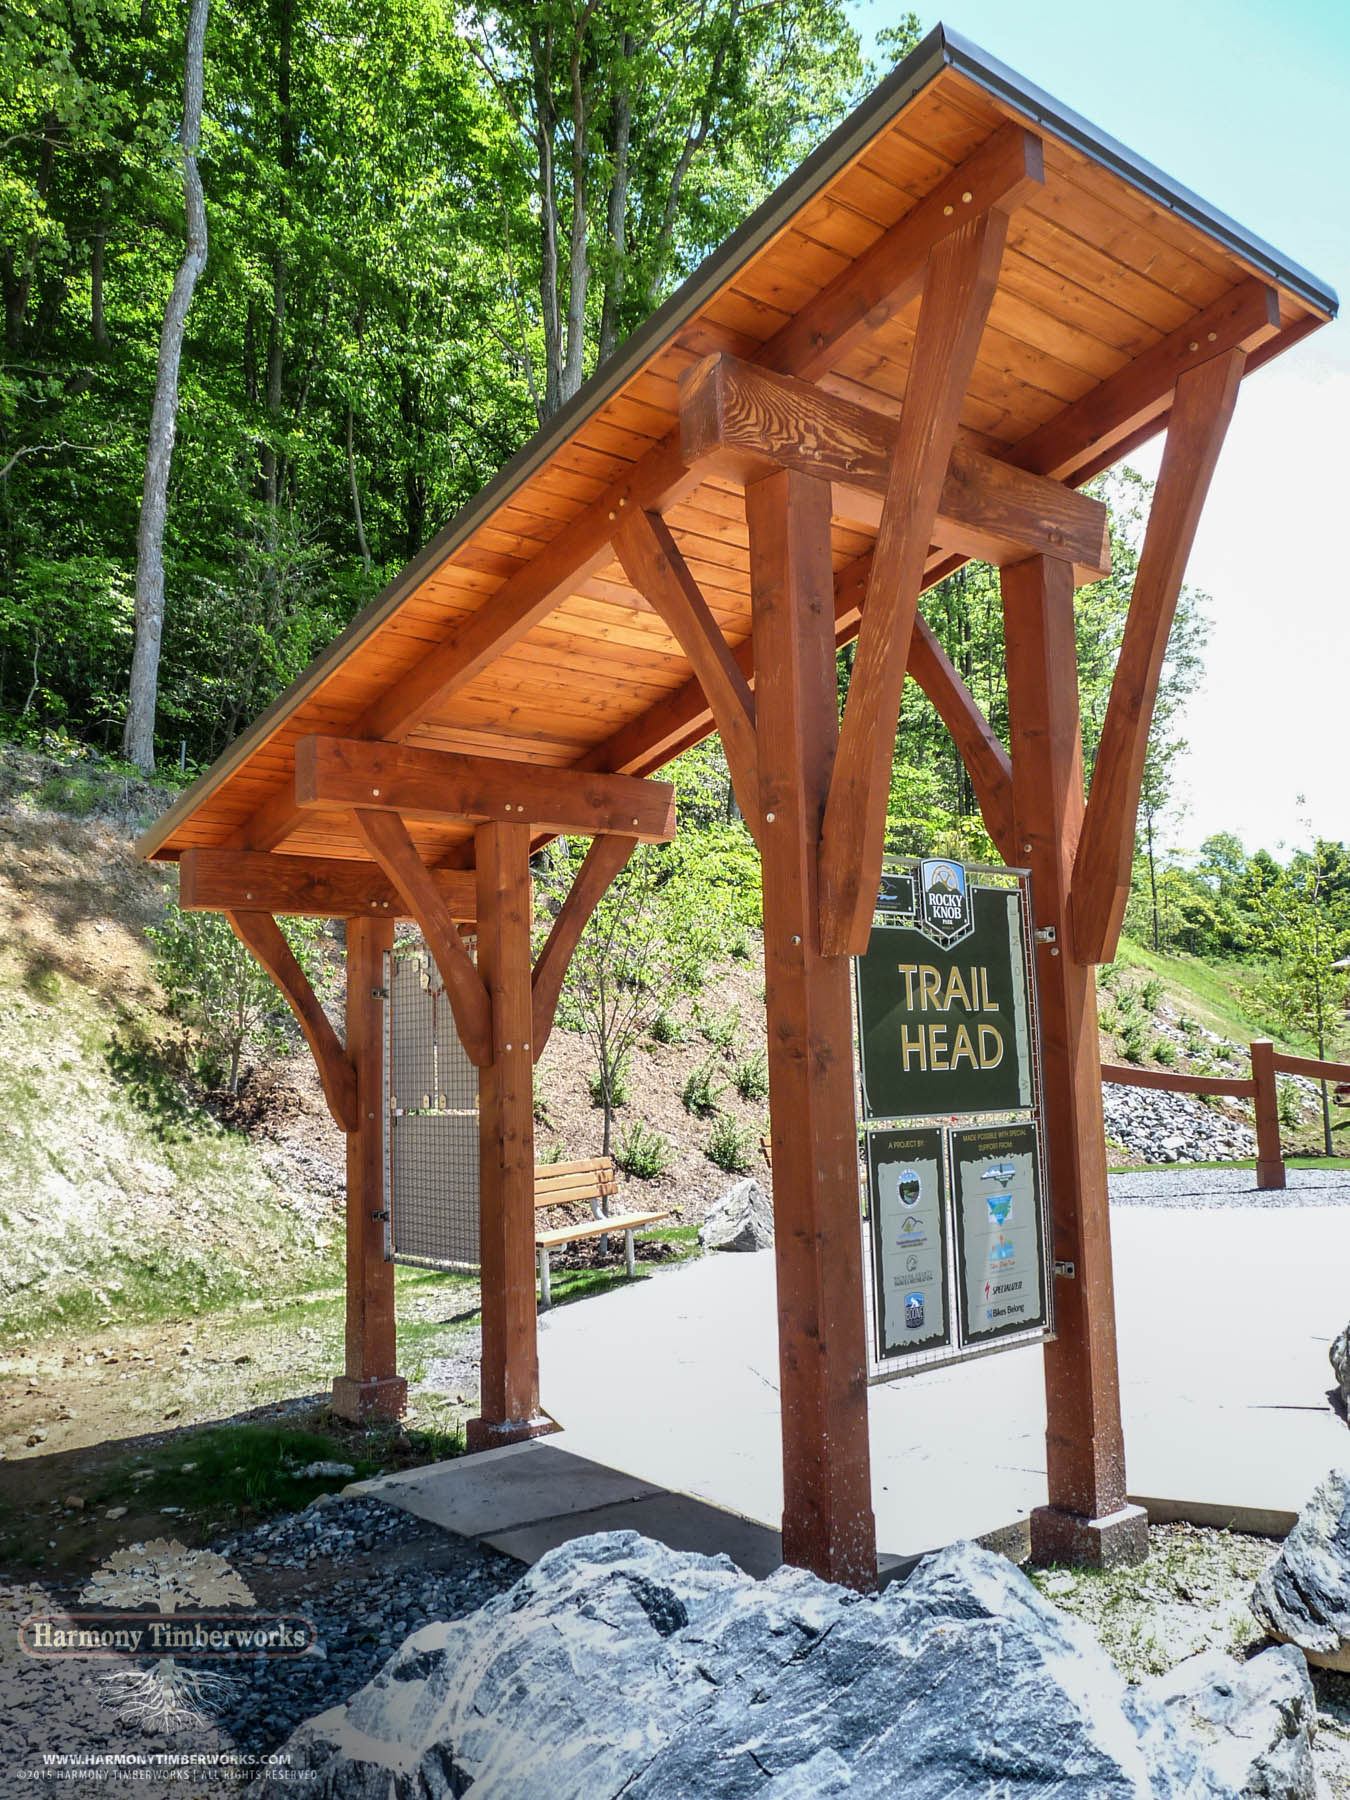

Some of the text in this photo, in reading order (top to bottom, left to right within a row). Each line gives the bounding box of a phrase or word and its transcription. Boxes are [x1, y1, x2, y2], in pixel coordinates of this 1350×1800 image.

[929, 893, 962, 907] ROCKY
[933, 906, 962, 919] KNOB
[898, 964, 999, 1011] TRAIL
[901, 1024, 1003, 1071] HEAD
[894, 1140, 916, 1149] PROJECT
[992, 1281, 1022, 1295] SPECIALIZED
[993, 1304, 1024, 1318] Bikes Belong
